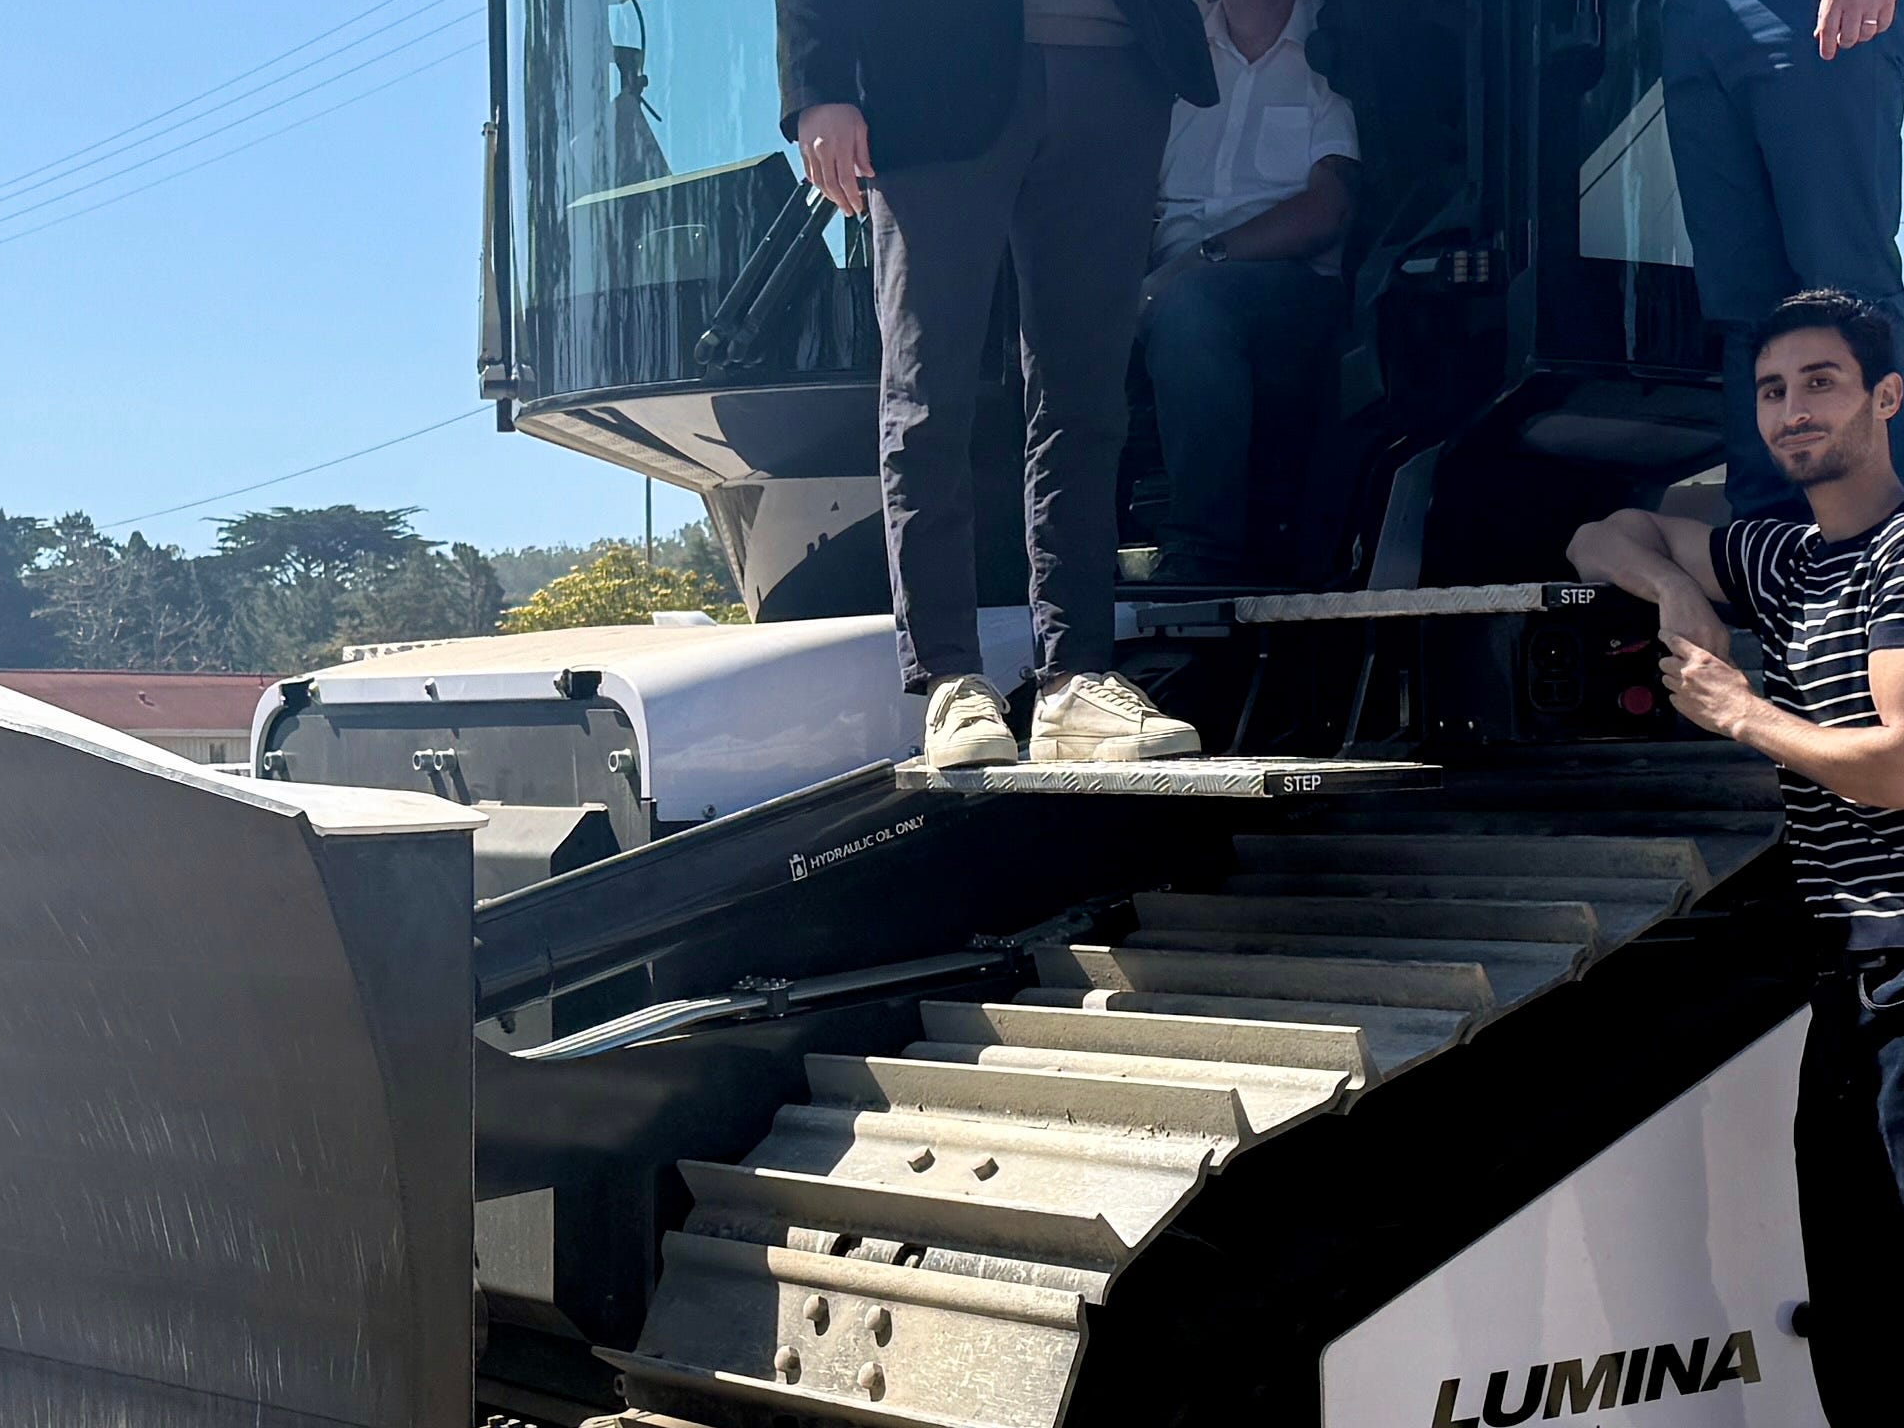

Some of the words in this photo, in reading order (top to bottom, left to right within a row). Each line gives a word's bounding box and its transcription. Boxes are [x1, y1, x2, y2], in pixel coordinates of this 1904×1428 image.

[1560, 588, 1596, 605] STEP
[810, 834, 875, 869] HYDRAULIC
[875, 828, 895, 842] OIL
[895, 814, 925, 835] ONLY
